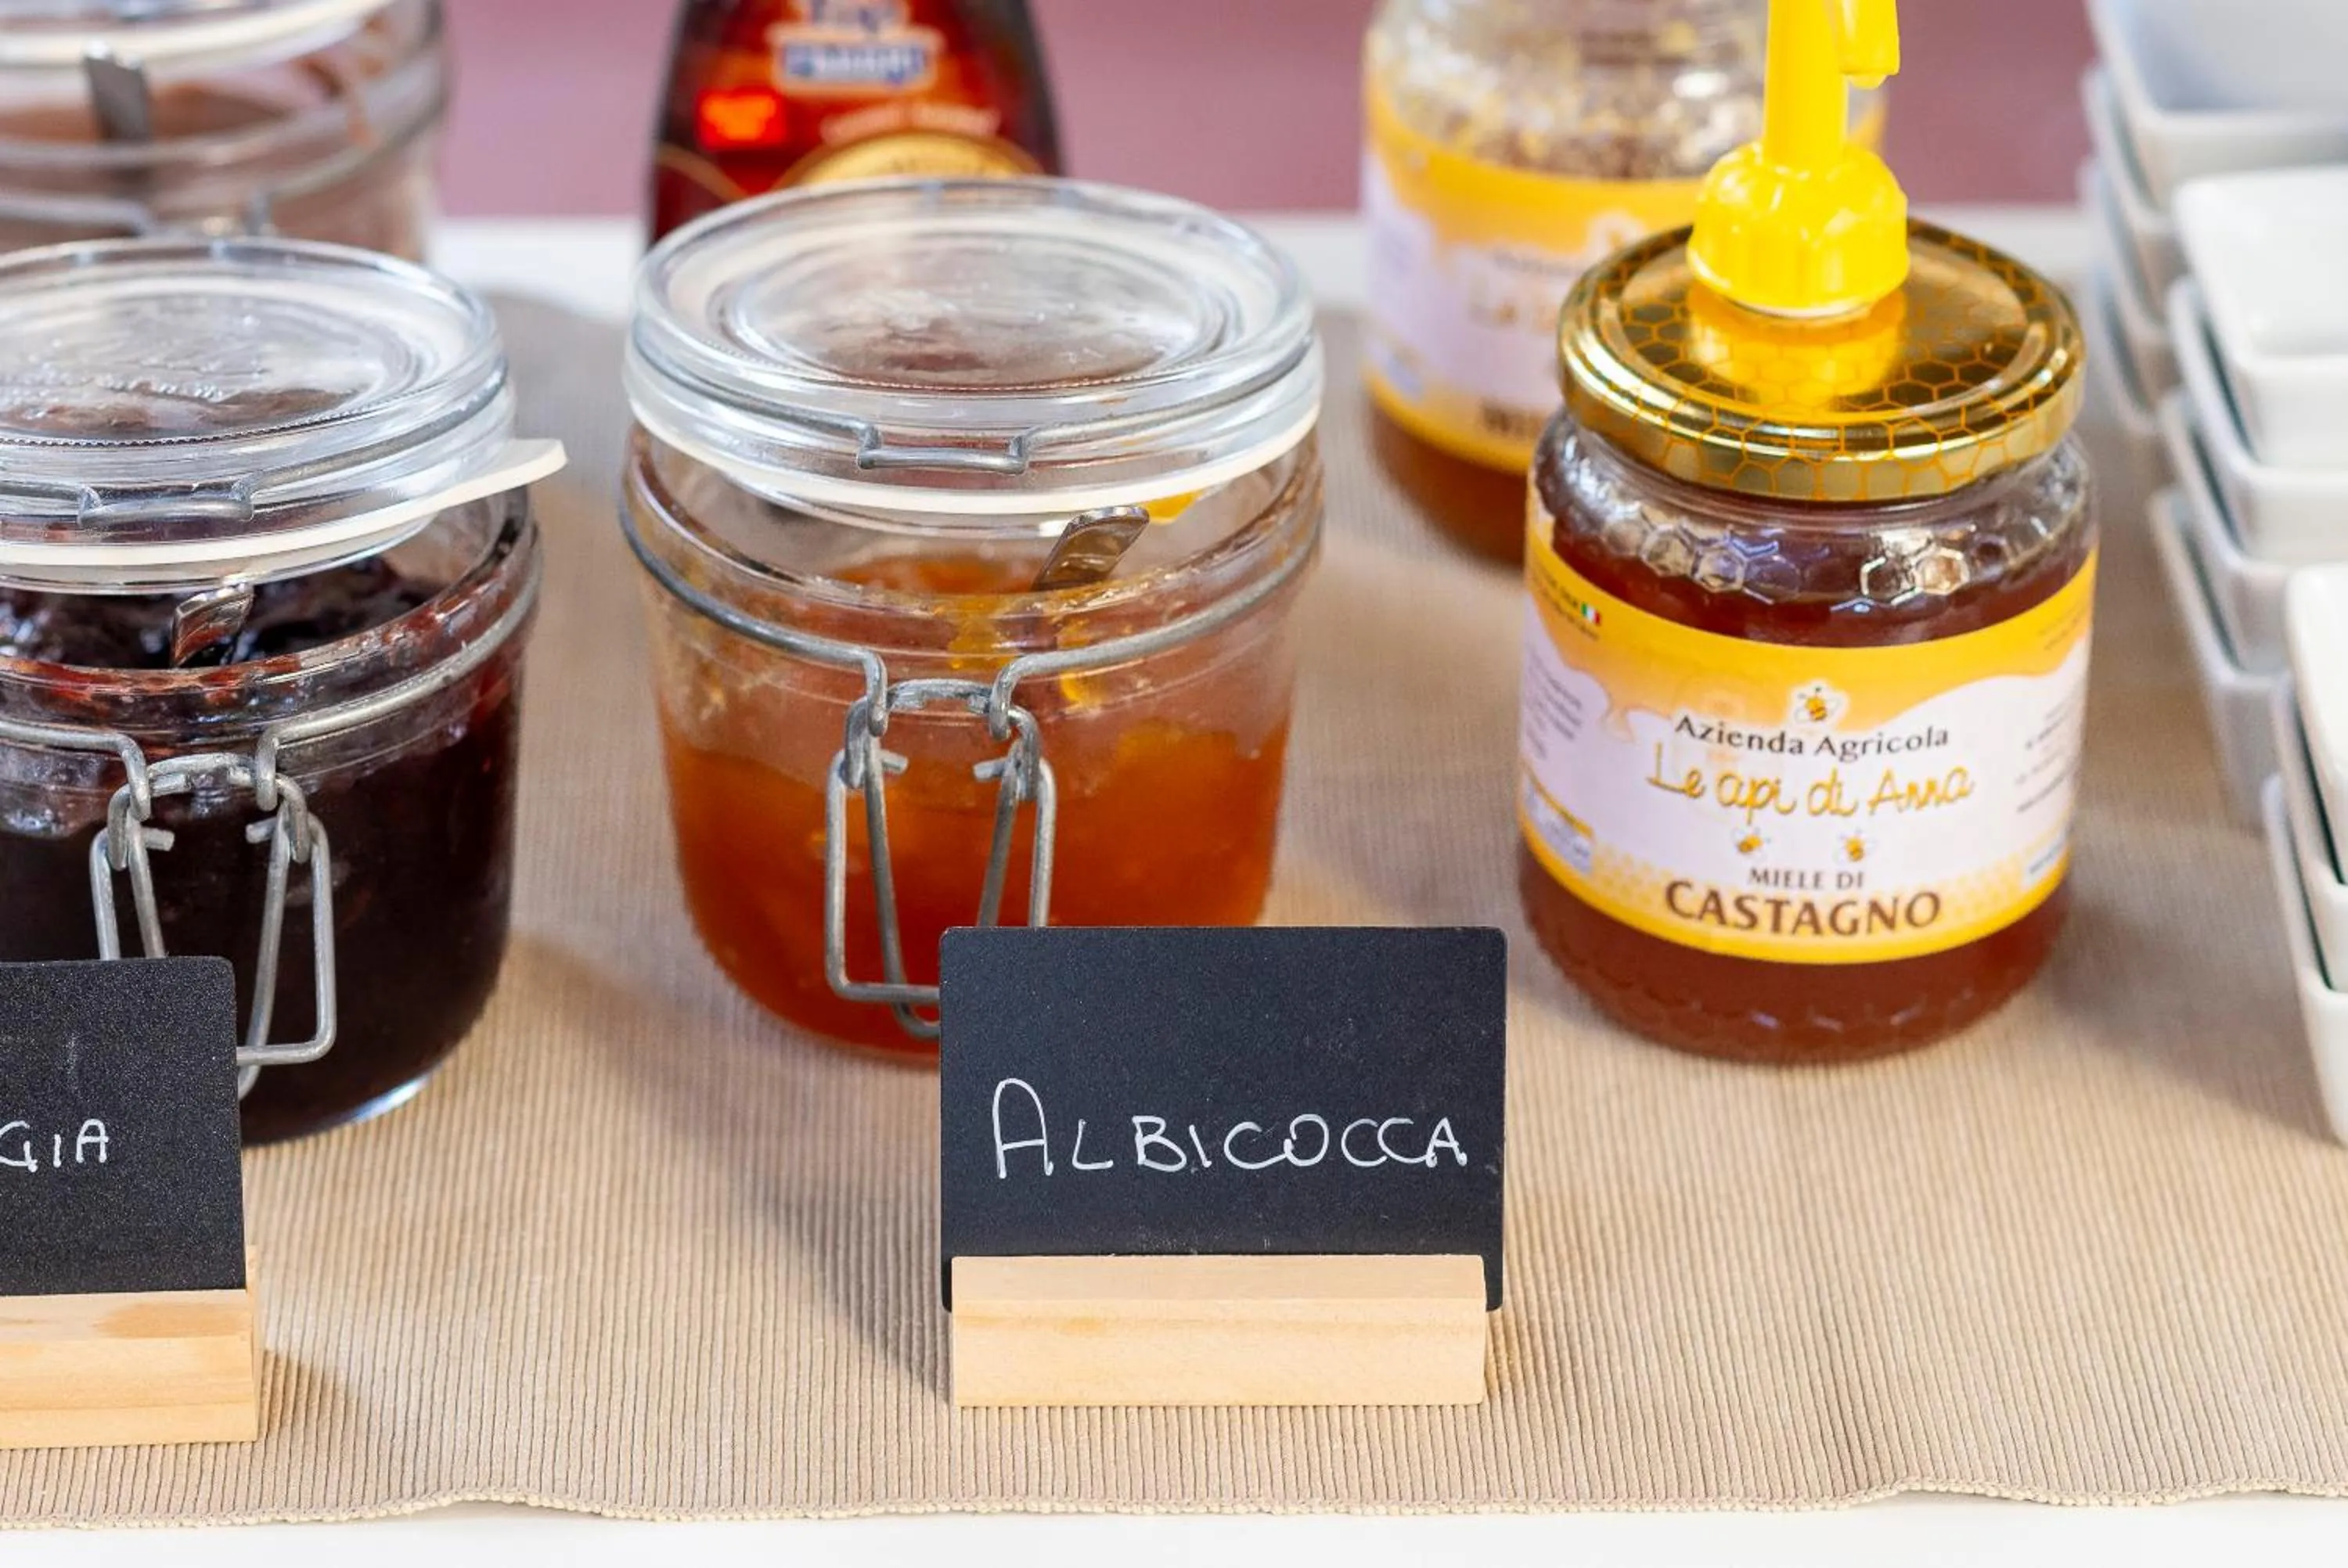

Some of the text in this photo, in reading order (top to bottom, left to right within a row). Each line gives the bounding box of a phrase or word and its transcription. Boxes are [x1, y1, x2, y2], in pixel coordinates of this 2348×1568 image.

[1674, 715, 1950, 763] Azienda Agricola
[1646, 743, 1975, 825] Le api di Anna
[1748, 868, 1864, 890] MIELE DI
[1665, 880, 1943, 936] CASTAGNO
[992, 1077, 1468, 1179] ALBICOCCA
